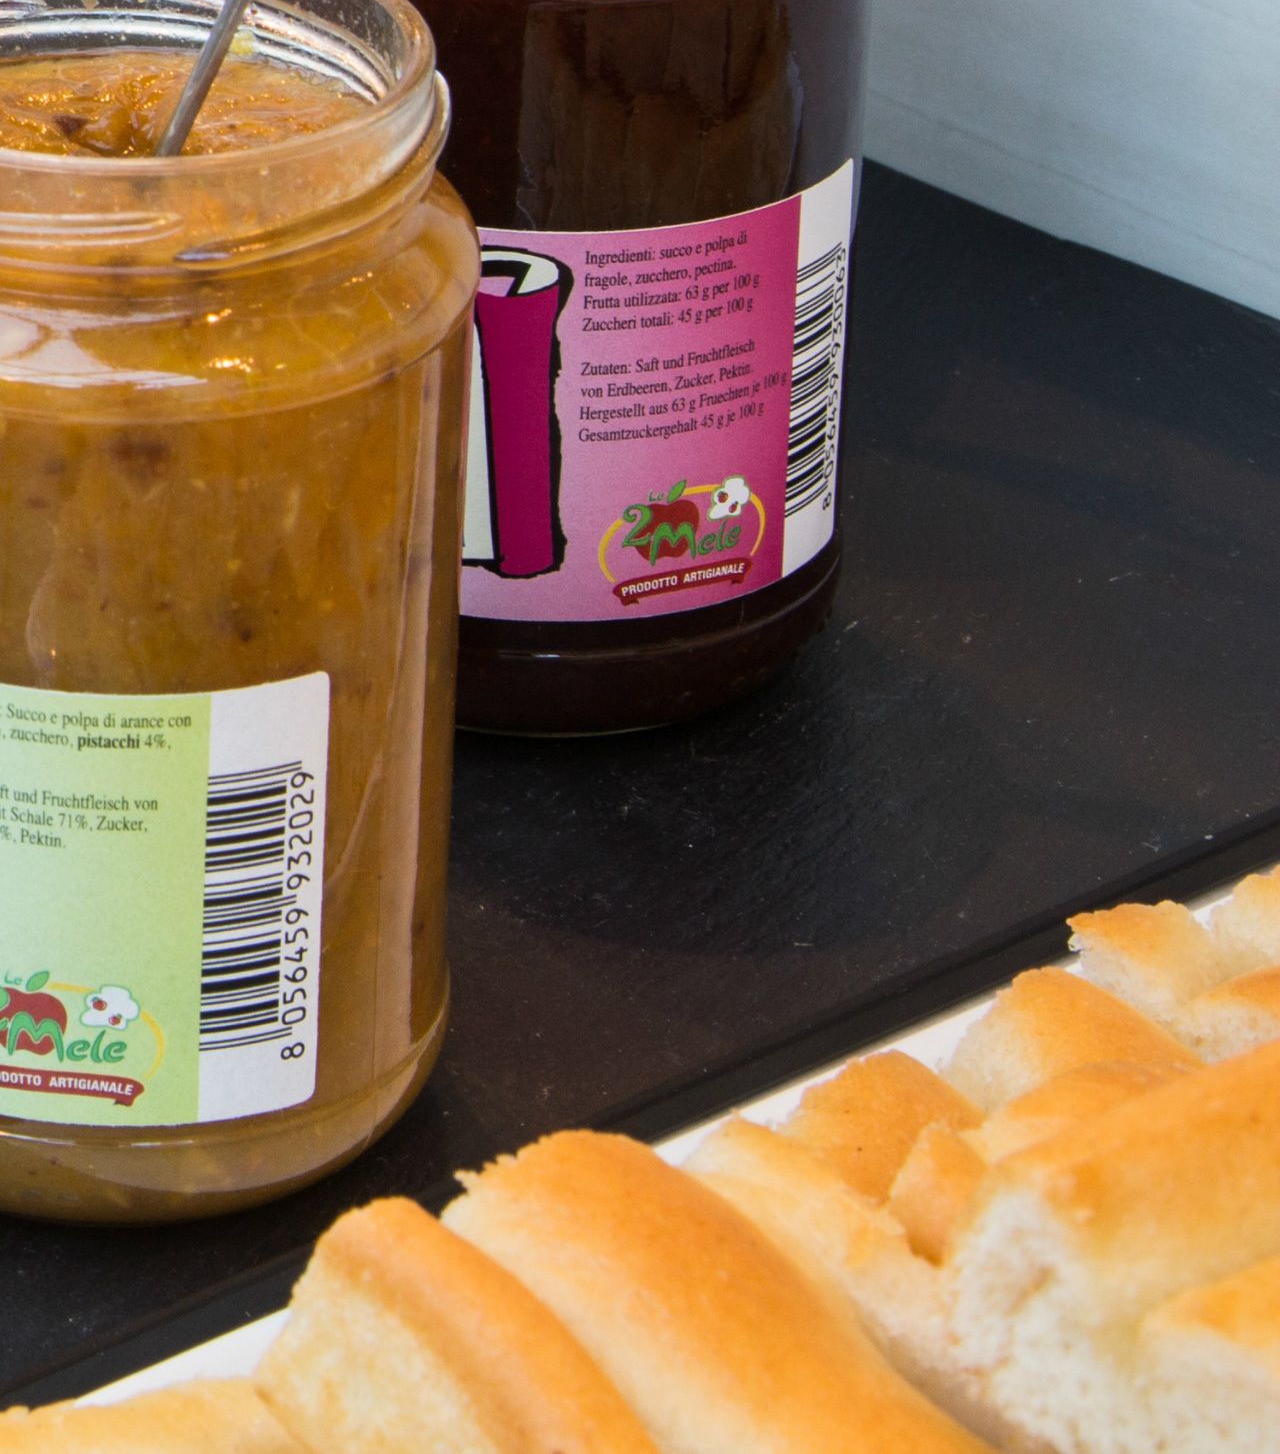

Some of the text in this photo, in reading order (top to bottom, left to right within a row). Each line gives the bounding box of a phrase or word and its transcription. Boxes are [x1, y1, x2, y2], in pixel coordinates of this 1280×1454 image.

[585, 231, 747, 268] Ingredienti: succo e polpa di
[583, 273, 760, 309] Frutta utilizzata: 63 g per 100 g
[584, 272, 632, 290] fragole,
[582, 297, 753, 331] Zuccheri totali: 45 g per 100 g
[581, 338, 755, 376] Zutaten: Saft und Fruchtfleisch
[579, 403, 645, 423] Hergestellt
[649, 404, 668, 416] aus
[671, 398, 685, 412] 63
[689, 399, 695, 413] g
[751, 381, 760, 397] je
[580, 387, 602, 398] von
[578, 418, 697, 442] Gesamtzuckergehalt
[700, 414, 714, 428] 45
[717, 414, 723, 427] g
[726, 410, 735, 427] je
[757, 402, 765, 417] g
[650, 520, 741, 566] Mele
[621, 562, 745, 597] PRODOTTO ARTIGIANALE
[6, 704, 46, 723] Succo
[50, 714, 58, 724] e
[62, 712, 99, 733] polpa
[103, 712, 115, 727] di
[120, 717, 164, 728] arance
[168, 715, 192, 727] con
[77, 734, 140, 750] pistacchi
[13, 787, 37, 804] und
[42, 790, 129, 810] Fruchtfleisch
[134, 798, 158, 810] von
[10, 808, 53, 827] Schale
[96, 815, 147, 833] Zucker,
[20, 828, 66, 849] Pektin.
[280, 771, 314, 1061] 8 056459 932029
[4, 970, 22, 985] Le
[7, 1011, 127, 1063] Mele
[48, 1076, 134, 1096] ARTIGIANALE
